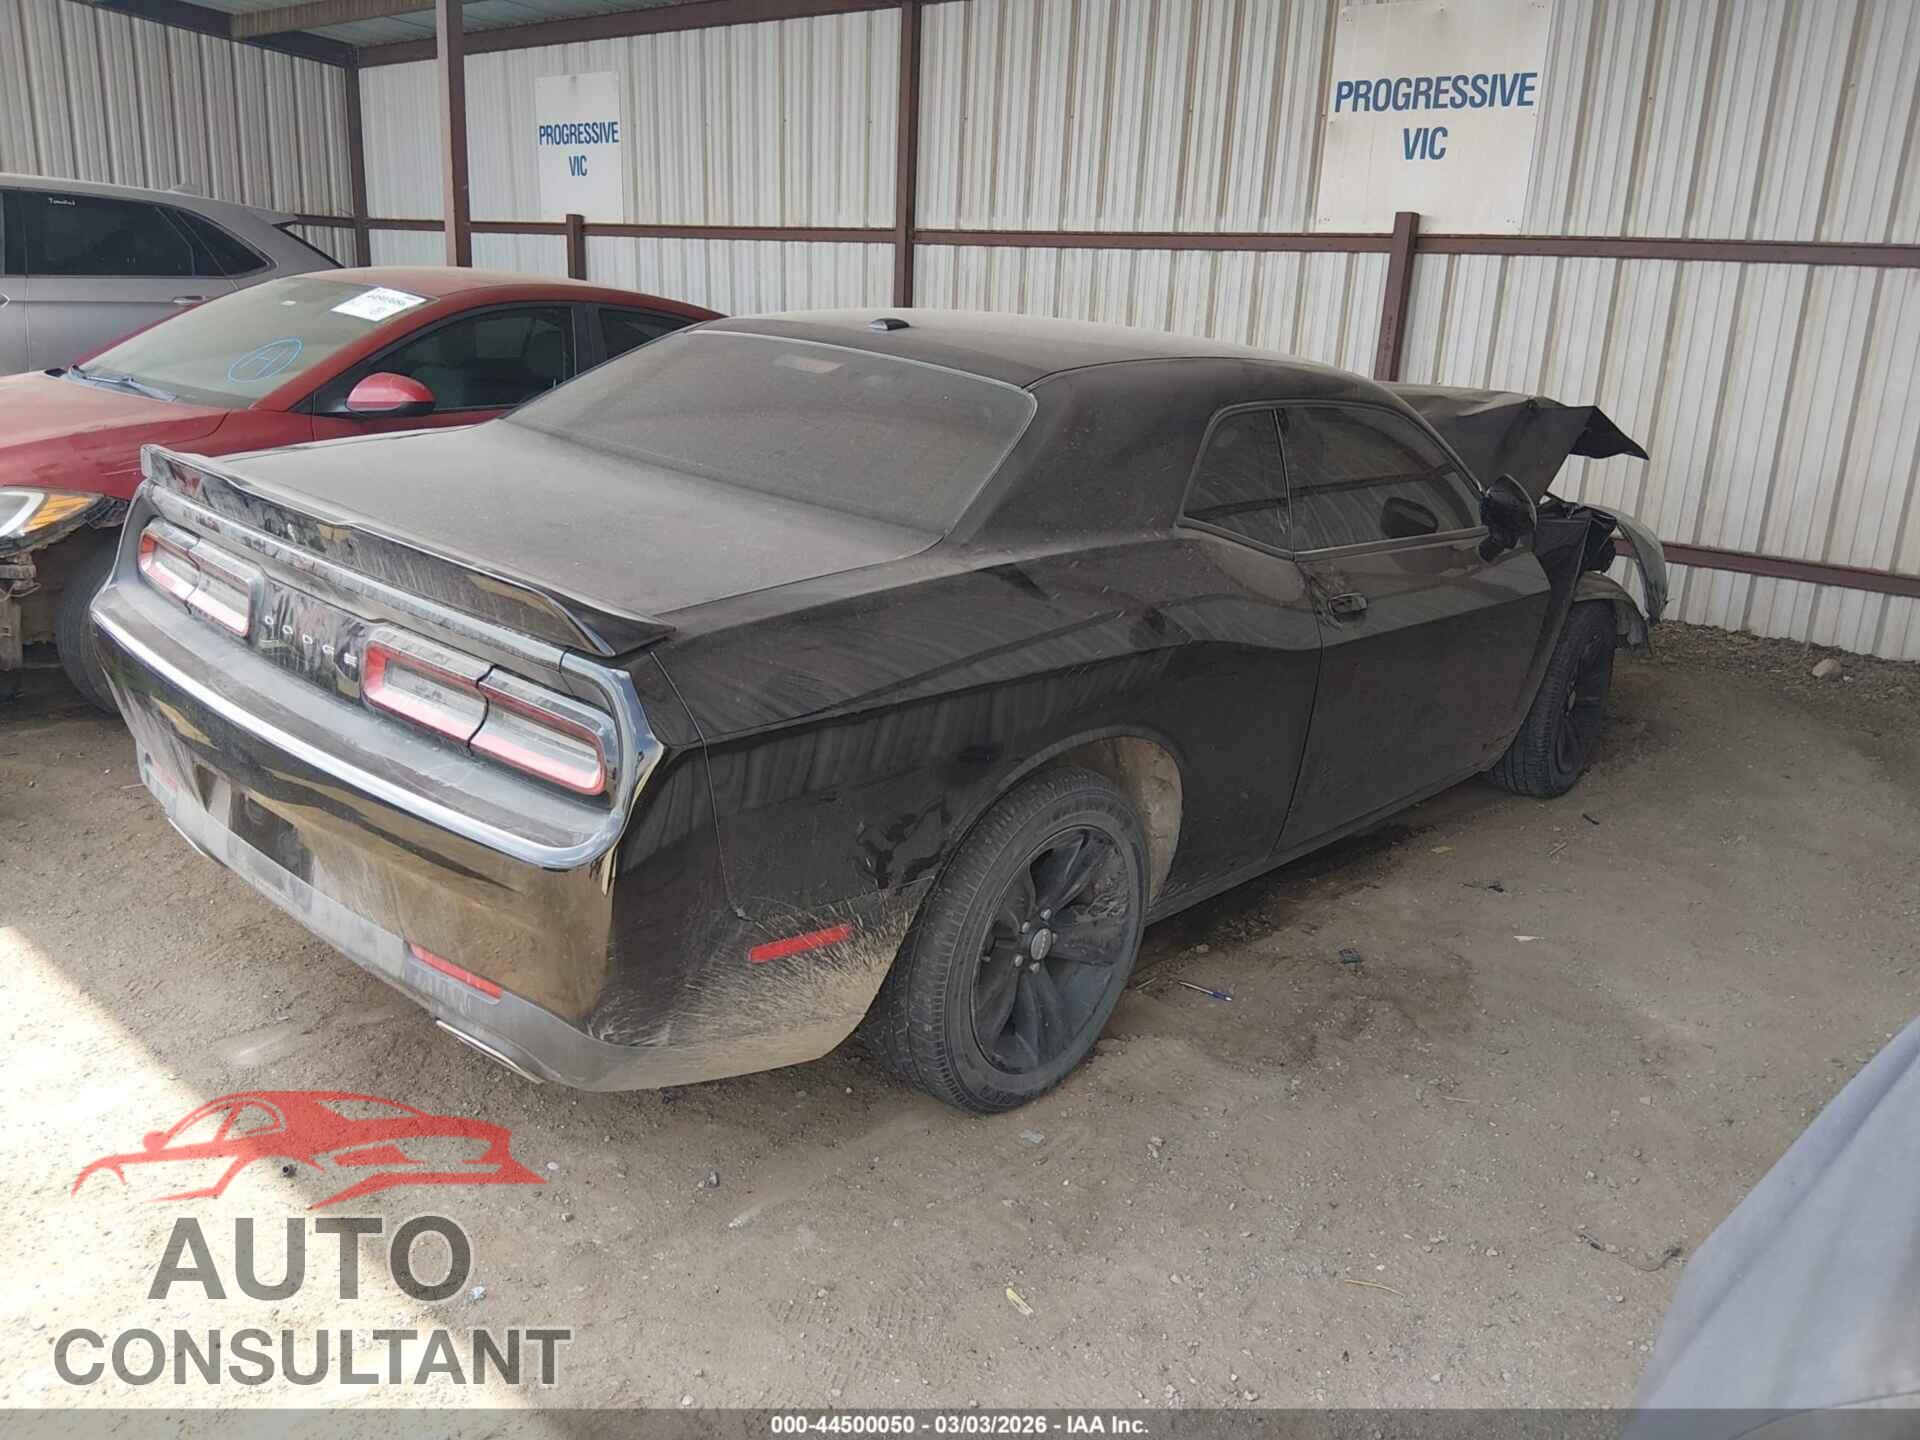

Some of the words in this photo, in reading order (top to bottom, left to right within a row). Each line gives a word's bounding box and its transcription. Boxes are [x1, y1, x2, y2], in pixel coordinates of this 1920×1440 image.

[1334, 72, 1538, 113] PROGRESSIVE
[539, 121, 620, 146] PROGRESSIVE
[1403, 126, 1449, 161] VIC
[568, 154, 588, 177] VIC
[264, 615, 358, 668] DODGE
